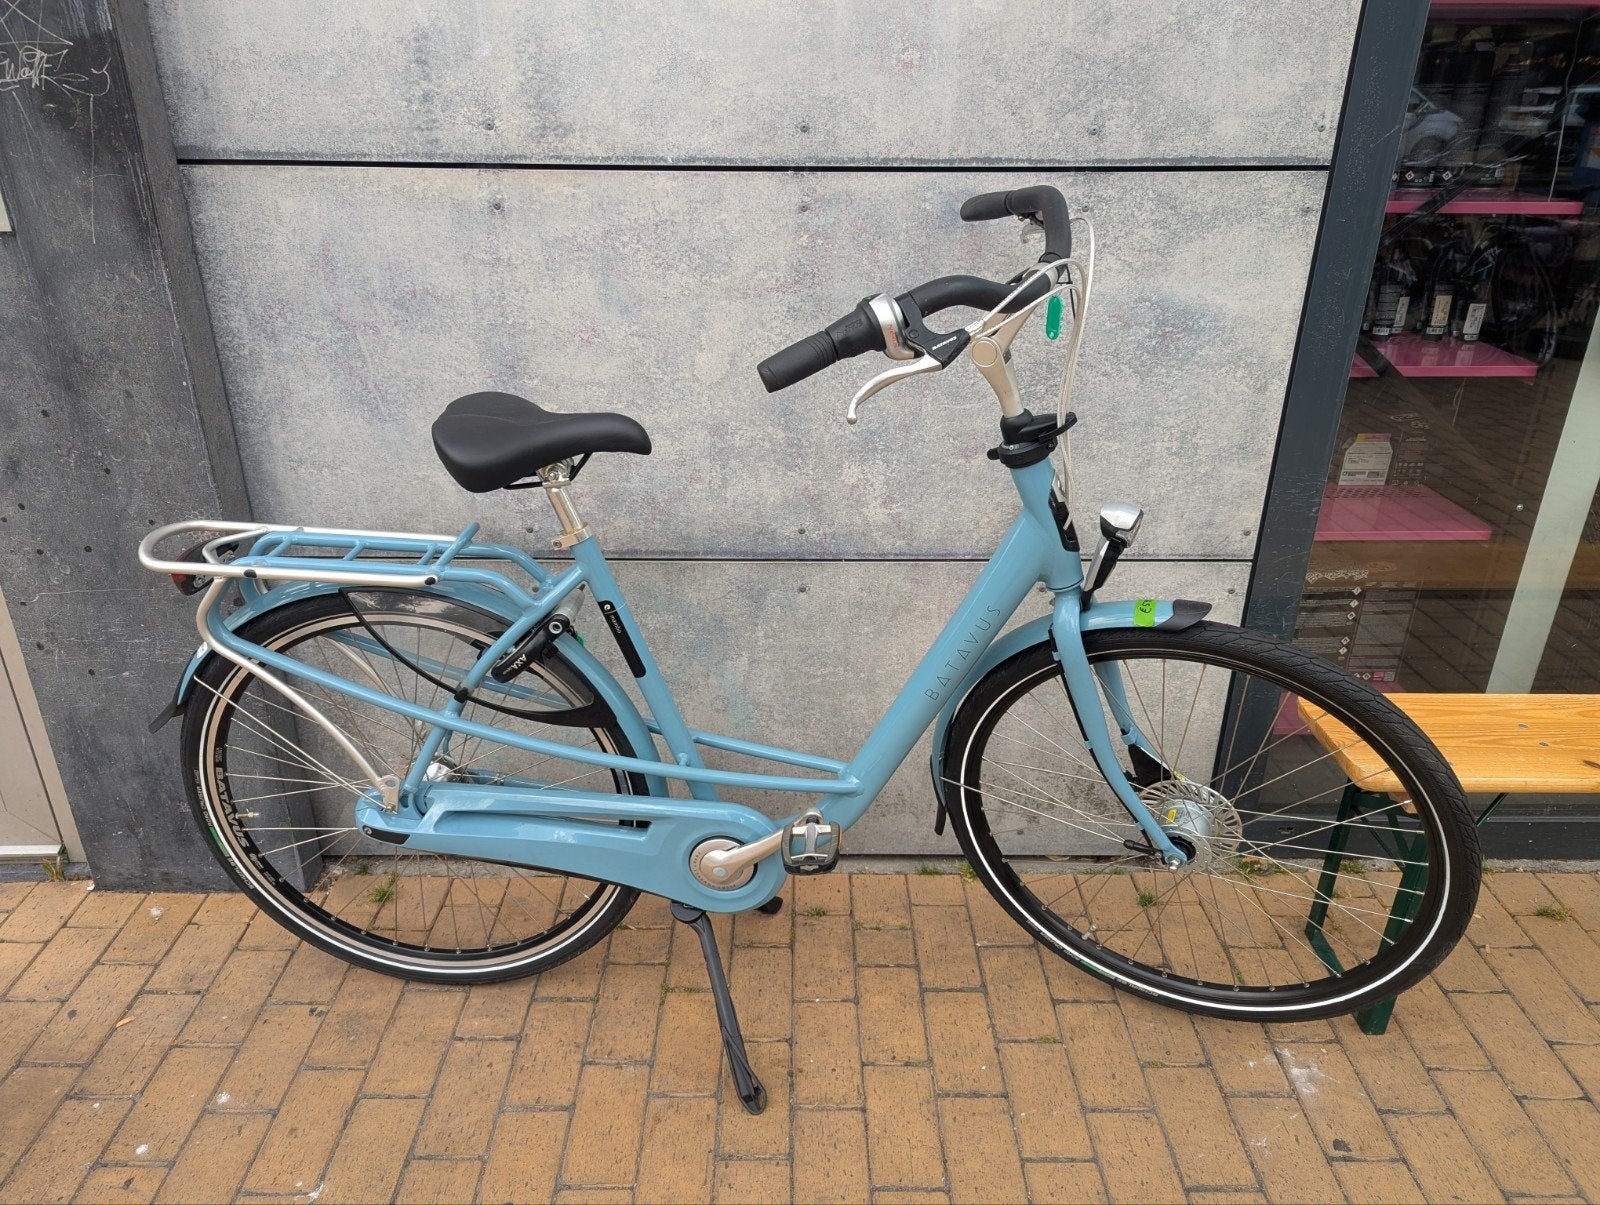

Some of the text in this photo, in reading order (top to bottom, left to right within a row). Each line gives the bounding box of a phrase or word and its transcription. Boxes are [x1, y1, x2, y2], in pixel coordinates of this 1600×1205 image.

[510, 653, 527, 669] AXA
[924, 605, 1001, 701] BATAVUS
[215, 767, 250, 847] BATAVUS
